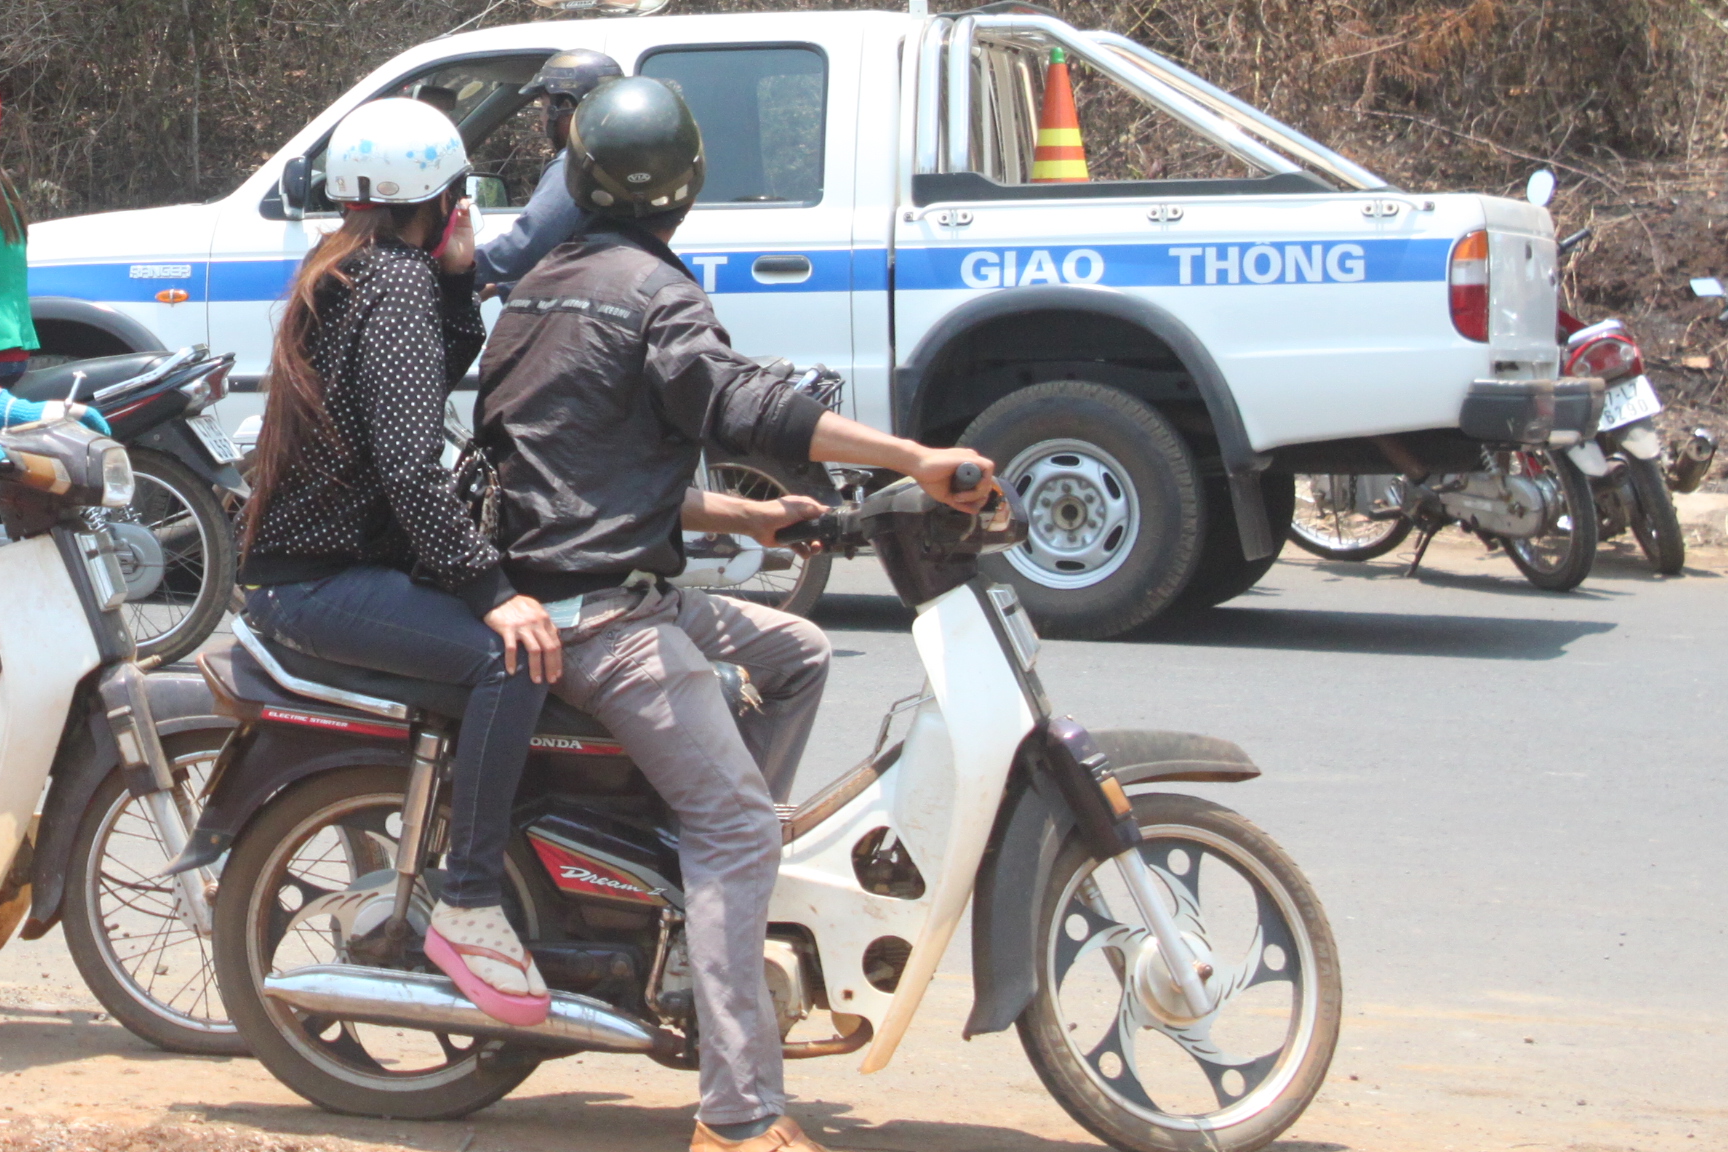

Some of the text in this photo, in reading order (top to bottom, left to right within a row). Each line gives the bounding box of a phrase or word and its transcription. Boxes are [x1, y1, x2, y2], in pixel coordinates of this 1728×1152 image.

[129, 264, 191, 279] RANGER
[960, 248, 1104, 289] GIAO
[1168, 241, 1366, 285] THÔNG
[1604, 383, 1638, 406] 7-L7
[267, 710, 349, 728] ELECTRIC STARTER
[529, 736, 583, 750] ONDA
[559, 865, 645, 893] Dream
